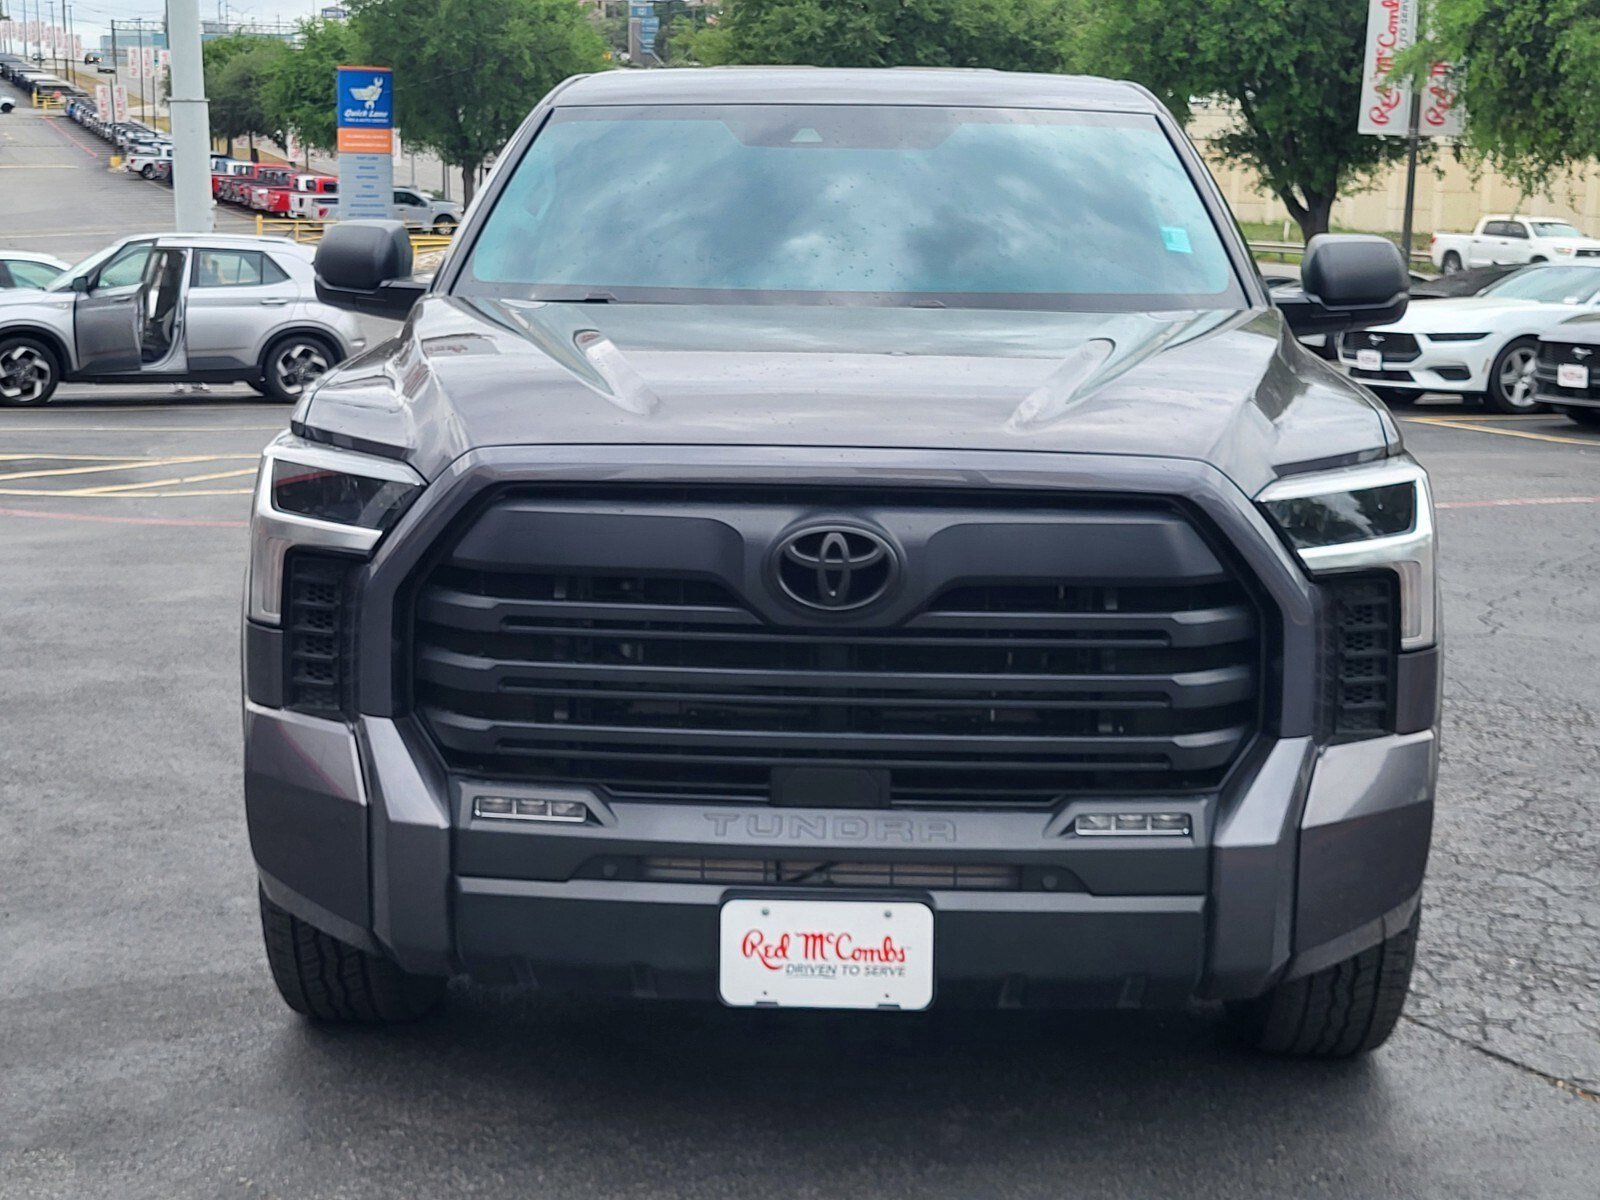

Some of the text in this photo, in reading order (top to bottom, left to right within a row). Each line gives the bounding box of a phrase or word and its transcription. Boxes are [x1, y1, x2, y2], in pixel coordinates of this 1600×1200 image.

[1369, 0, 1401, 126] Red McComb
[703, 813, 957, 843] TUNDRA
[742, 929, 906, 971] Red McCombs
[785, 963, 906, 978] DRIVEN TO SERVE
